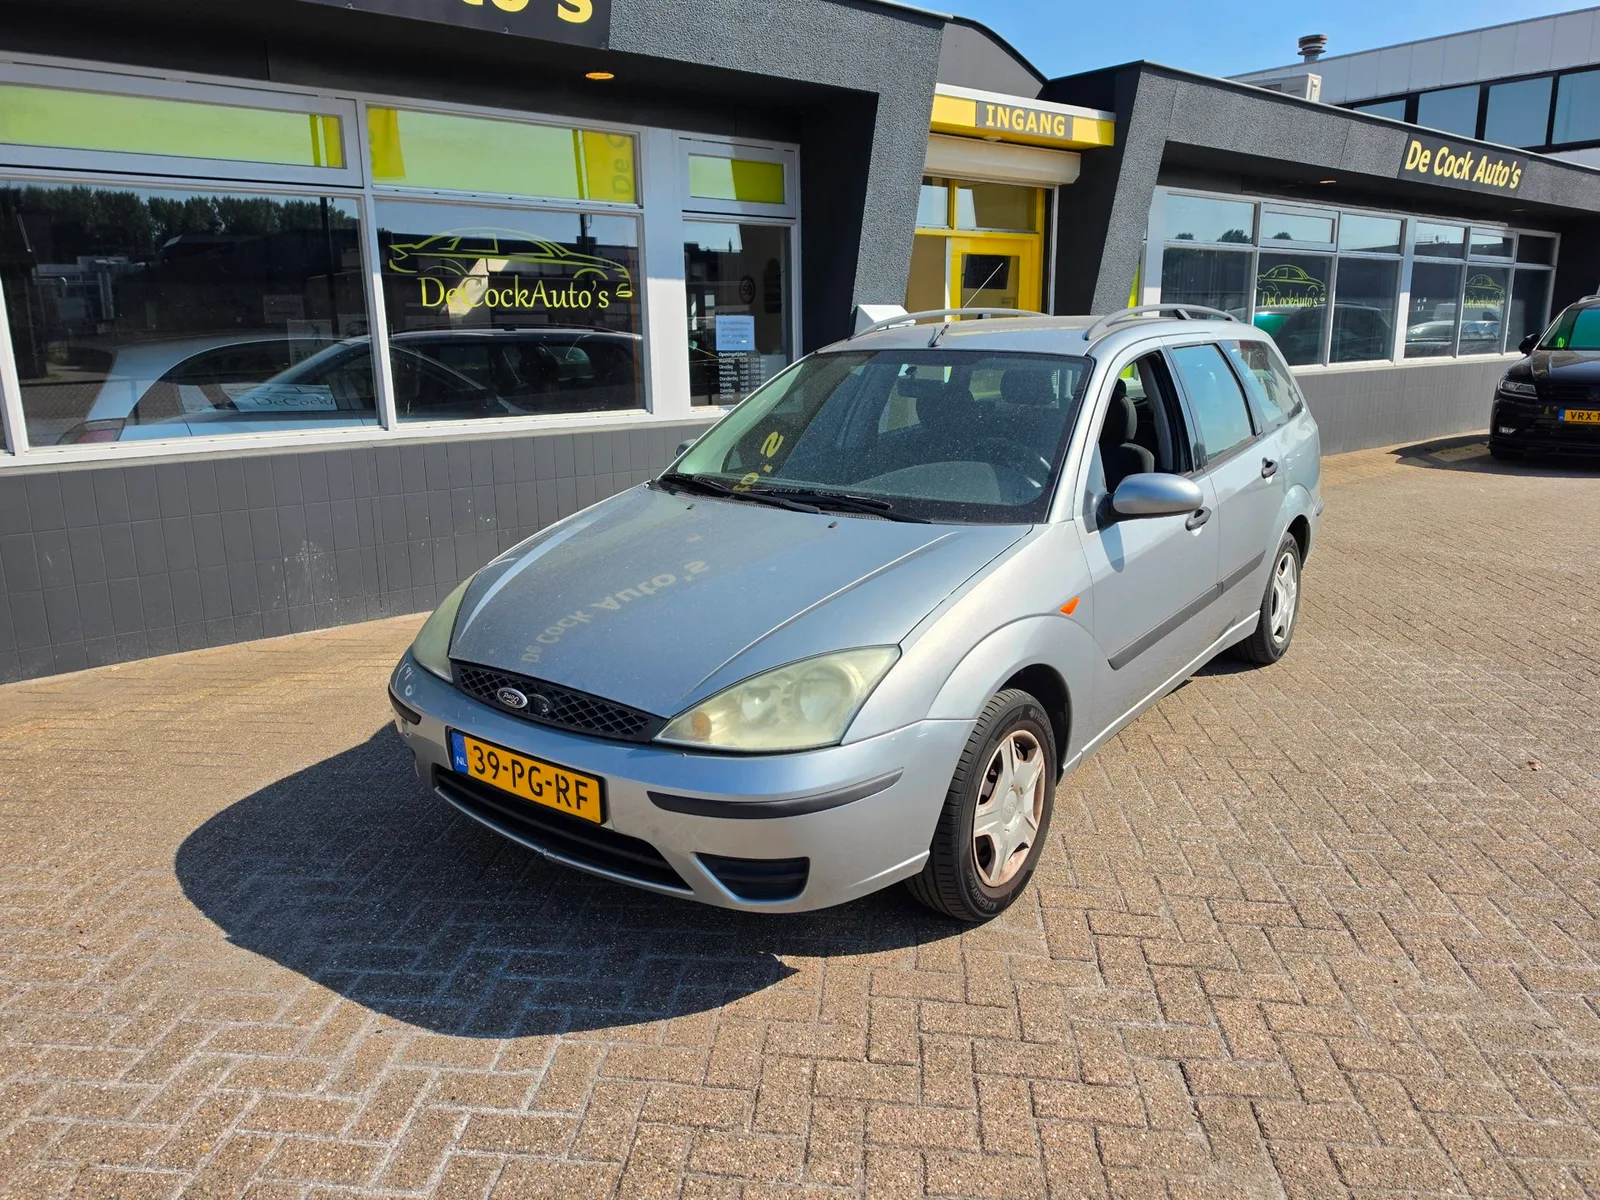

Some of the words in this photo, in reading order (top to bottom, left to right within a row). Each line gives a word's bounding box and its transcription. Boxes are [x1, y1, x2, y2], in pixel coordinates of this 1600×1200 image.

[986, 104, 1065, 137] INGANG
[1405, 140, 1431, 173] De
[1433, 146, 1474, 180] Cock
[1472, 155, 1521, 189] Auto's
[417, 274, 609, 309] DeCockAuto's
[1262, 289, 1318, 308] DeCockAuto's
[502, 692, 520, 706] Ford
[456, 755, 467, 767] NL
[473, 745, 588, 810] 39-PG-RF
